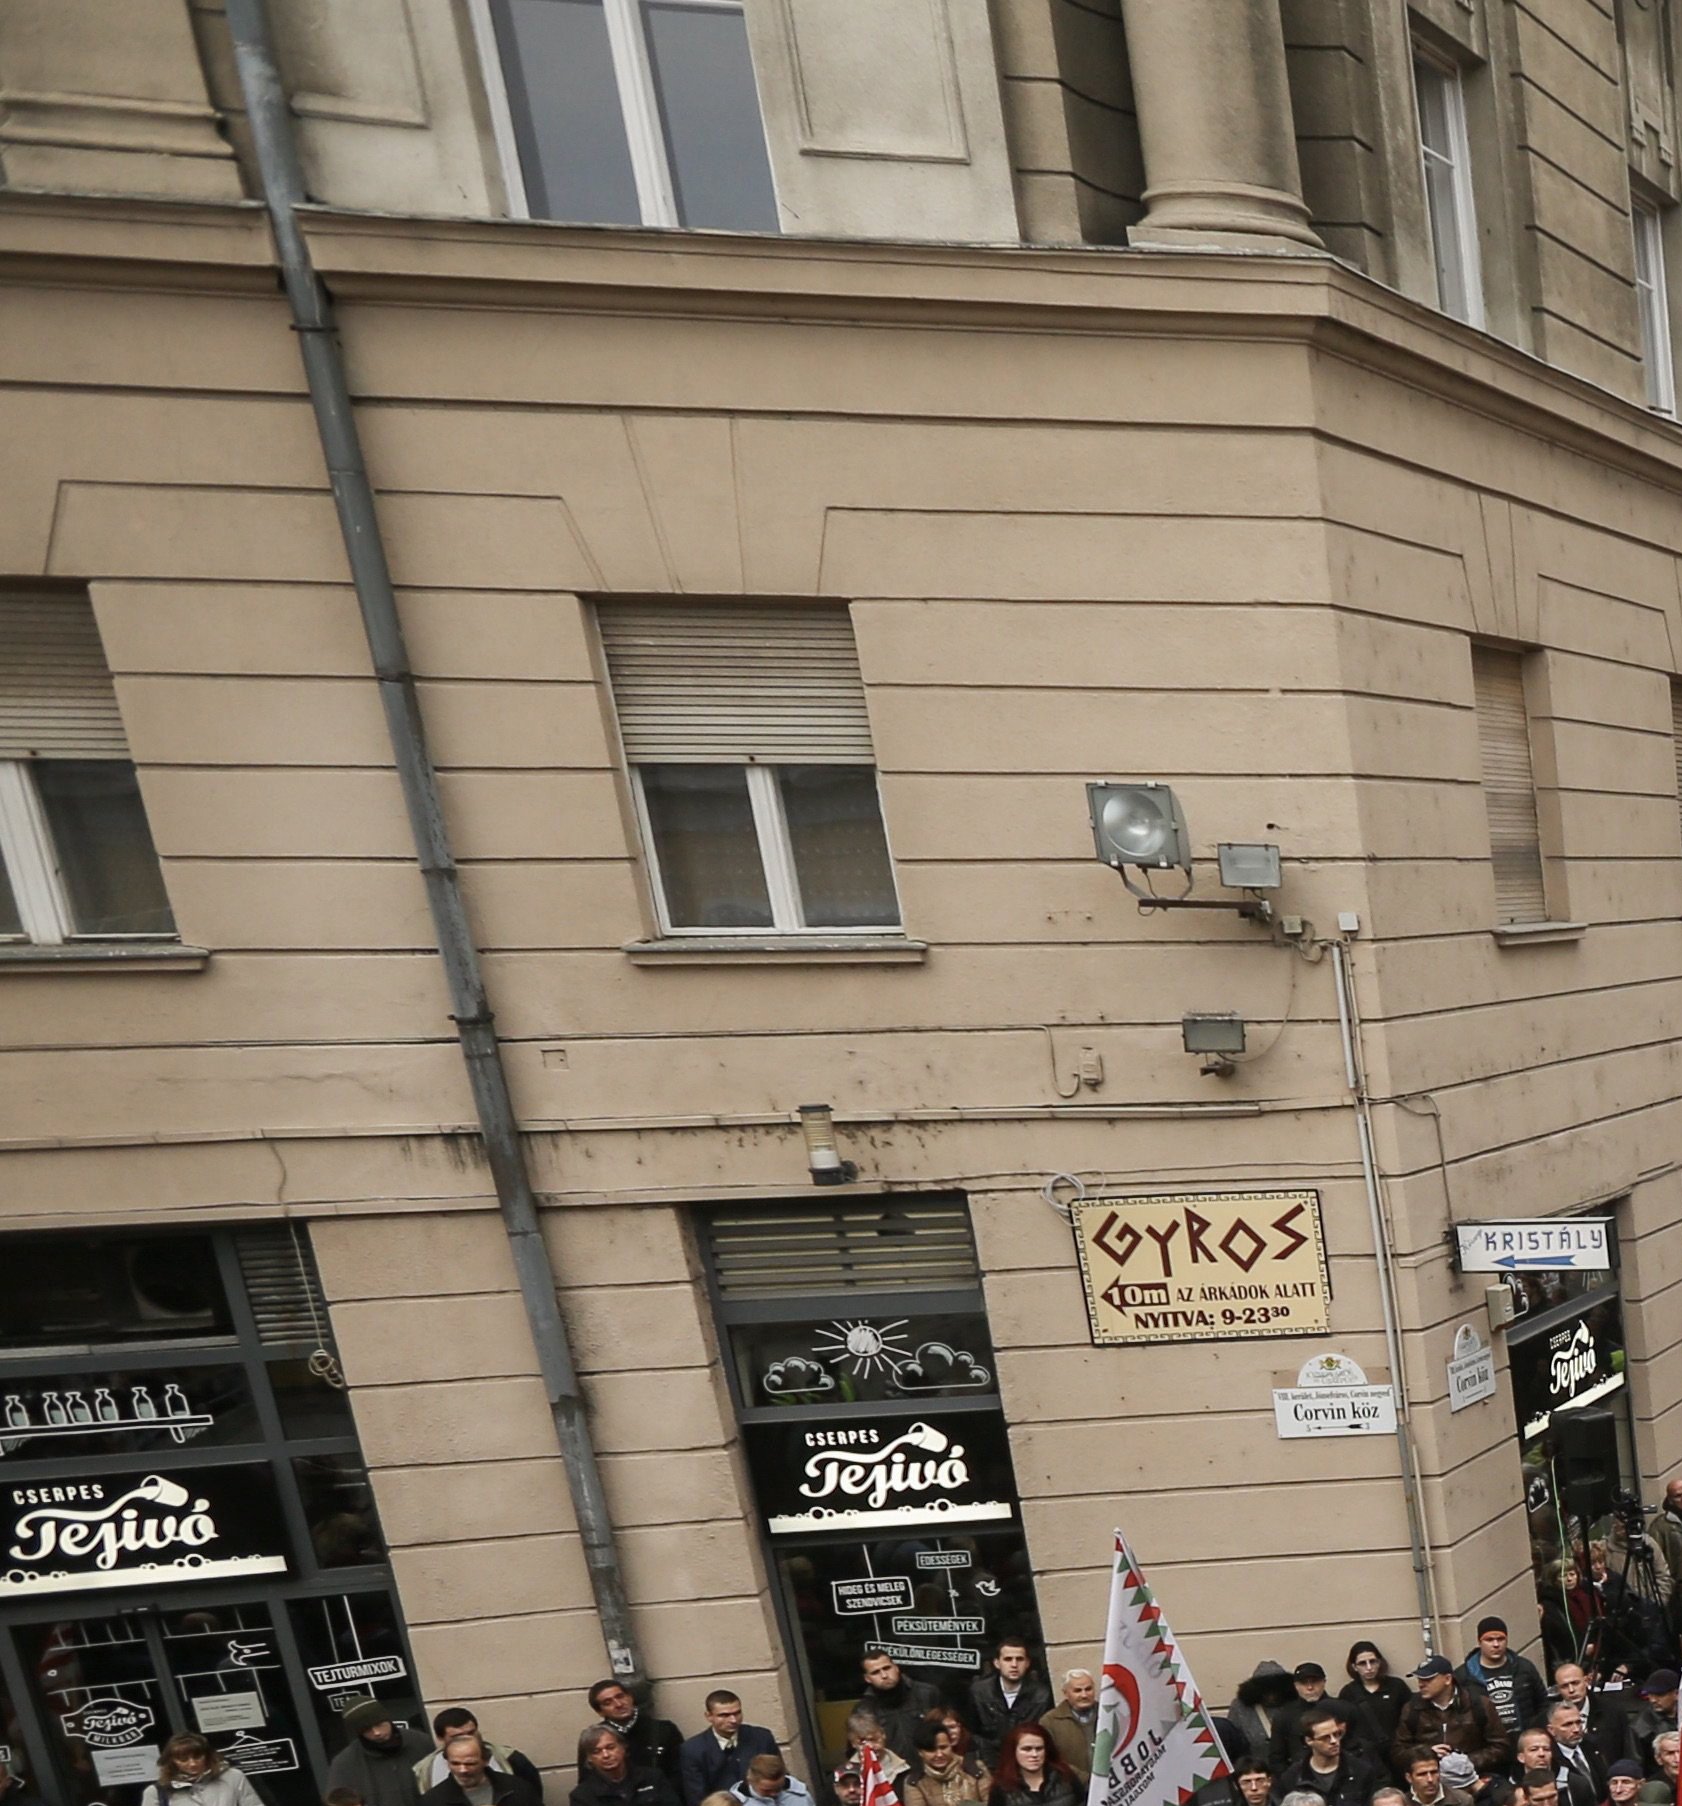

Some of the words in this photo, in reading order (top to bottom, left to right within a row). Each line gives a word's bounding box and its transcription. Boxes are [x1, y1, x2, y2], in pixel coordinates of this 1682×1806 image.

[1092, 1203, 1308, 1277] GYROS
[1484, 1227, 1603, 1251] KRISTÁLY
[1107, 1286, 1168, 1305] 10m
[1176, 1287, 1193, 1302] AZ
[1200, 1282, 1269, 1301] ÁRKÁDOK
[1274, 1282, 1316, 1298] ALATT
[1134, 1310, 1215, 1329] NYITVA:
[1550, 1336, 1596, 1397] Tejivó
[1456, 1371, 1477, 1394] Corvin
[1293, 1402, 1346, 1421] Corvin
[1350, 1400, 1380, 1419] köz
[805, 1429, 879, 1447] CSERPES
[799, 1444, 970, 1508] Tejivó
[13, 1484, 104, 1505] CSERPES
[9, 1497, 219, 1570] Tejivó
[838, 1584, 864, 1595] HIDEG
[865, 1582, 878, 1594] ÉS
[879, 1581, 905, 1592] MELEG
[846, 1595, 903, 1610] SZENDVICSEK
[896, 1618, 979, 1632] PÉKSÜTEMÉNYEK
[314, 1660, 397, 1684] TEJTURMIXOK
